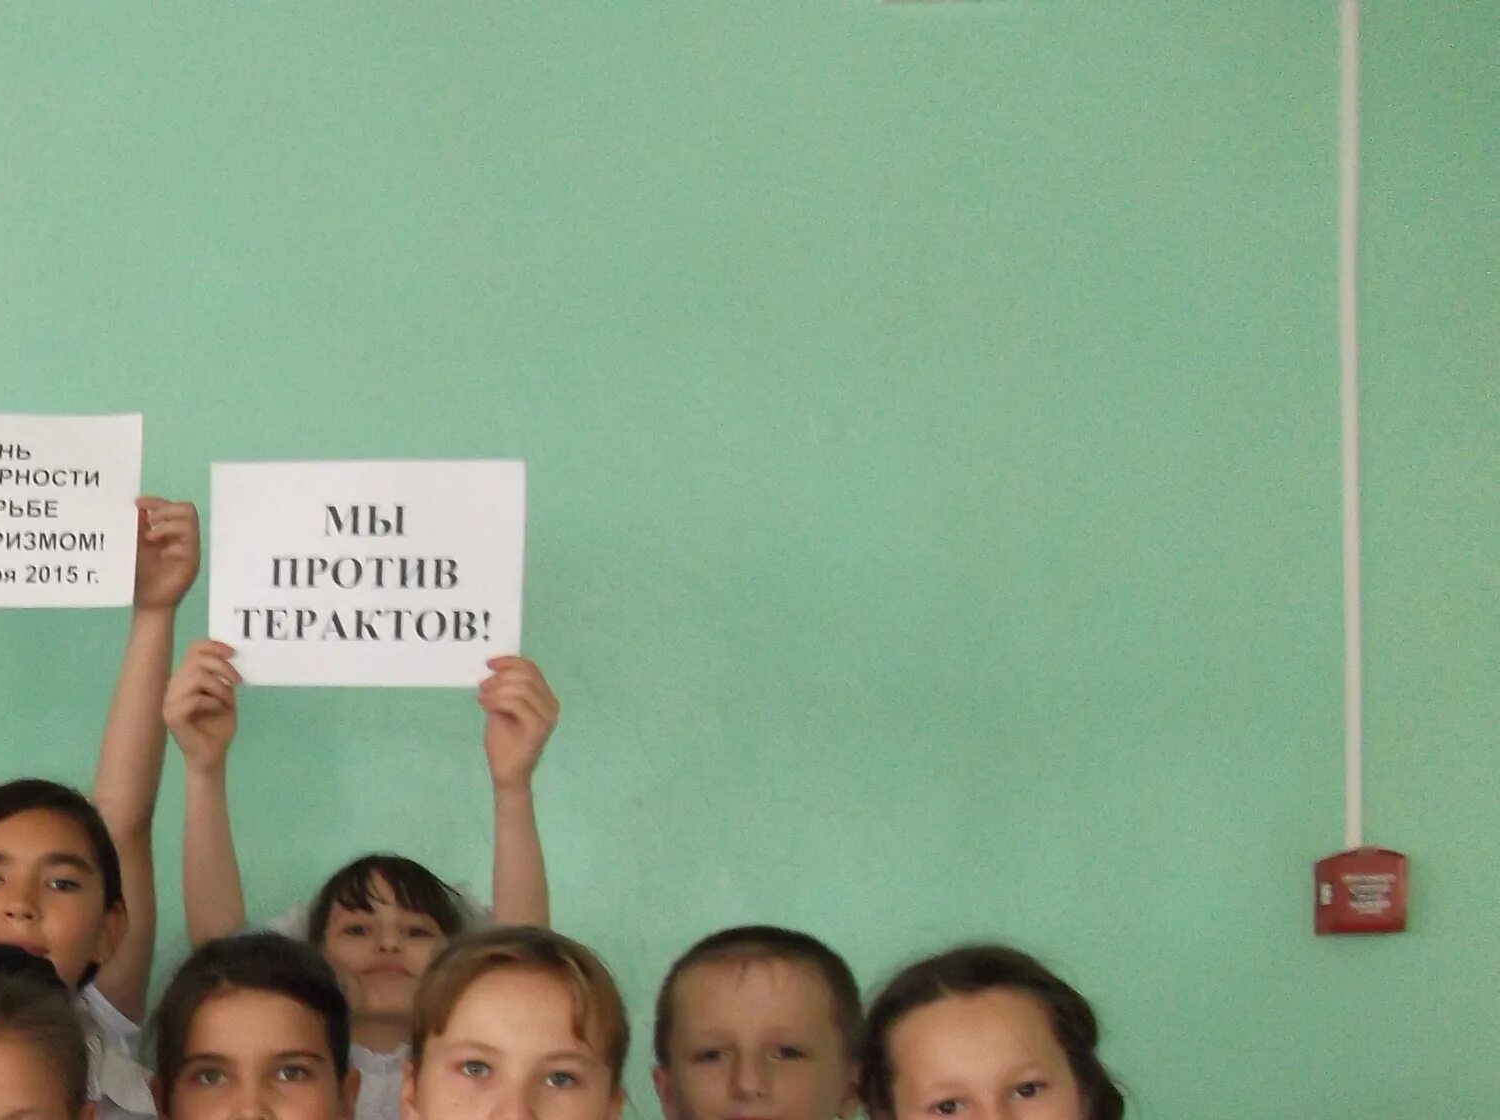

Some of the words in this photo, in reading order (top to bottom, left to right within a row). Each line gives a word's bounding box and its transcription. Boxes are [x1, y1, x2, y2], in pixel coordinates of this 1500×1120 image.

[326, 505, 404, 537] МЫ
[25, 565, 78, 584] 2015
[86, 569, 99, 584] г.
[272, 557, 458, 589] ПРОТИВ
[236, 609, 491, 642] ТЕРАКТОВ!
